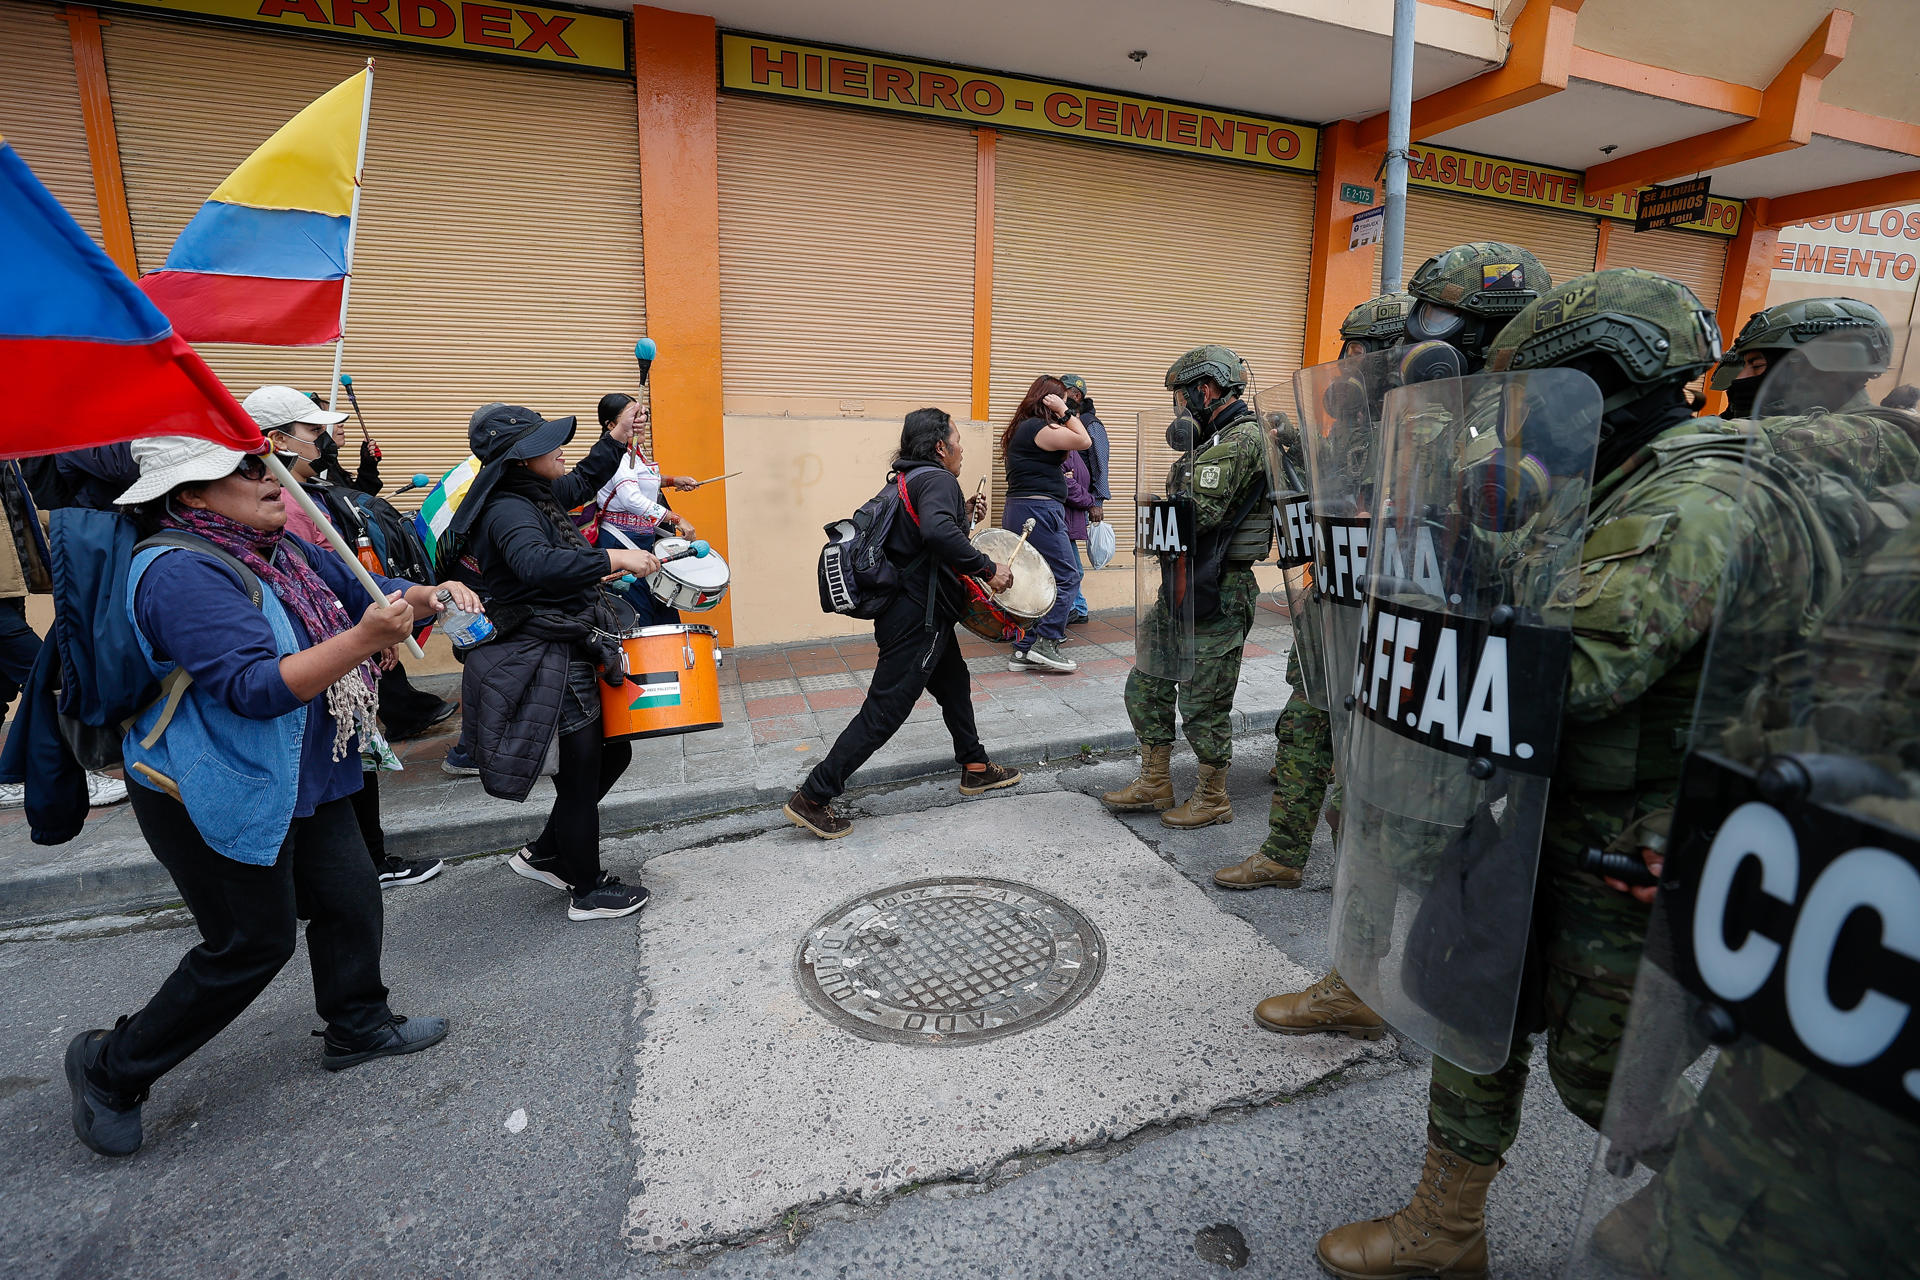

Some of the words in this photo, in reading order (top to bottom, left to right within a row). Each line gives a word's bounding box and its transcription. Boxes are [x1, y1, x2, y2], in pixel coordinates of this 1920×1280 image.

[751, 46, 1005, 116] HIERRO
[1044, 92, 1301, 160] CEMENTO
[1346, 188, 1350, 198] E
[1351, 189, 1370, 201] 2-175
[1644, 191, 1657, 203] SE
[1660, 181, 1705, 200] ALQUILA
[1640, 194, 1704, 219] ANDAMIOS
[1649, 218, 1667, 229] INF.
[1669, 212, 1693, 225] AQUI
[1353, 602, 1534, 759] C.FF.AA.
